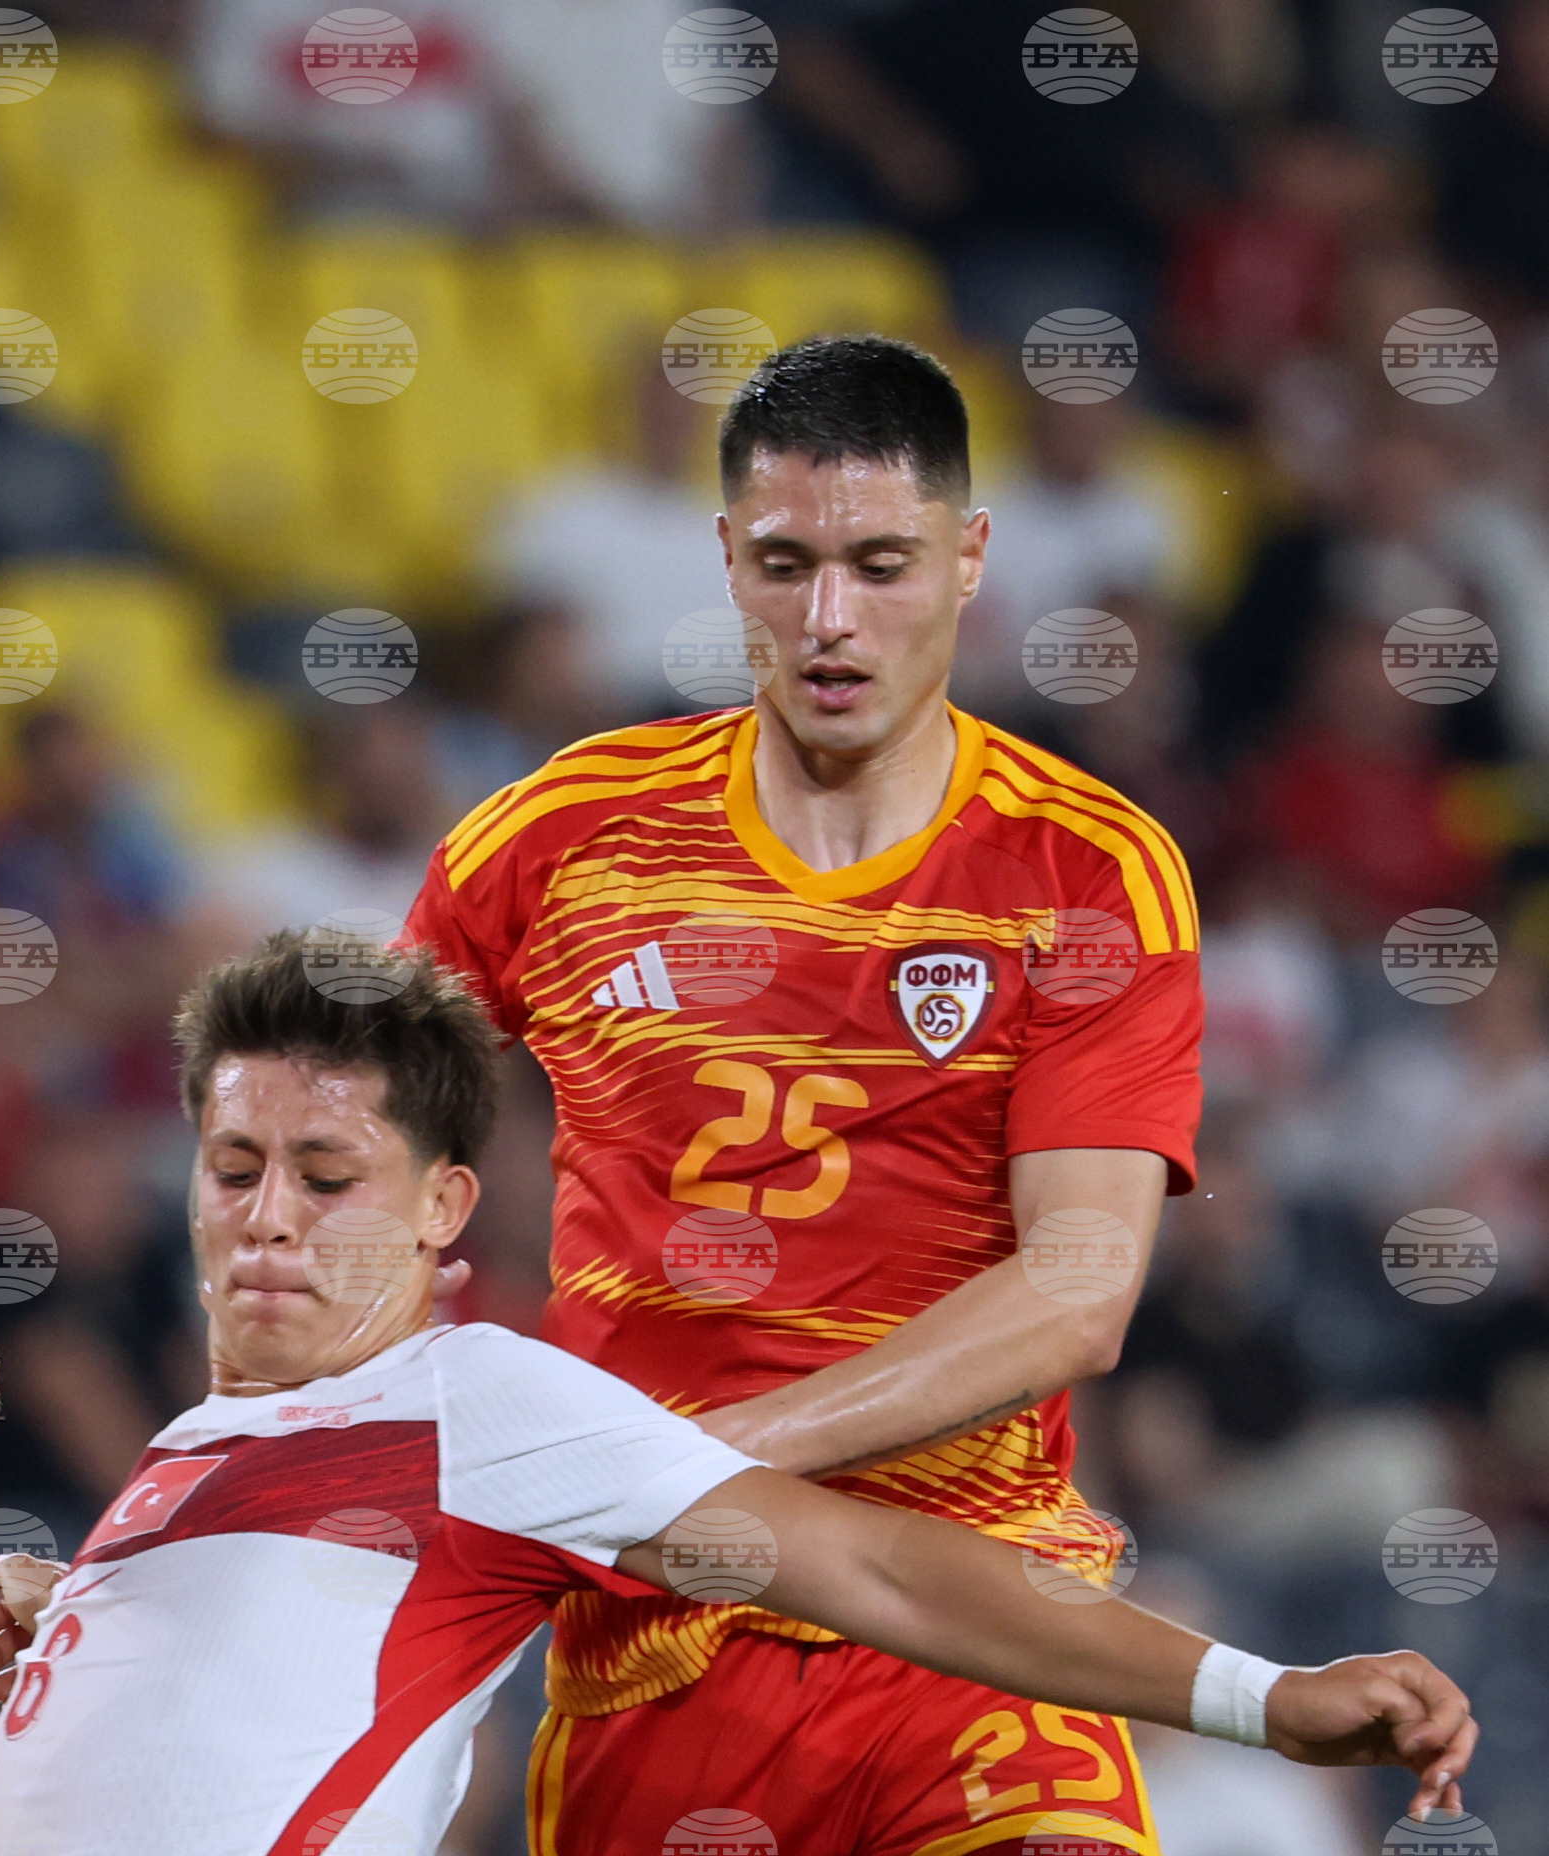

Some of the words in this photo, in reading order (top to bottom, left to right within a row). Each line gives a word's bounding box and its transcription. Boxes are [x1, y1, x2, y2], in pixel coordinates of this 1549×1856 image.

[906, 963, 977, 988] ФФМ
[669, 1058, 869, 1220] 25
[951, 1701, 1123, 1823] 25
